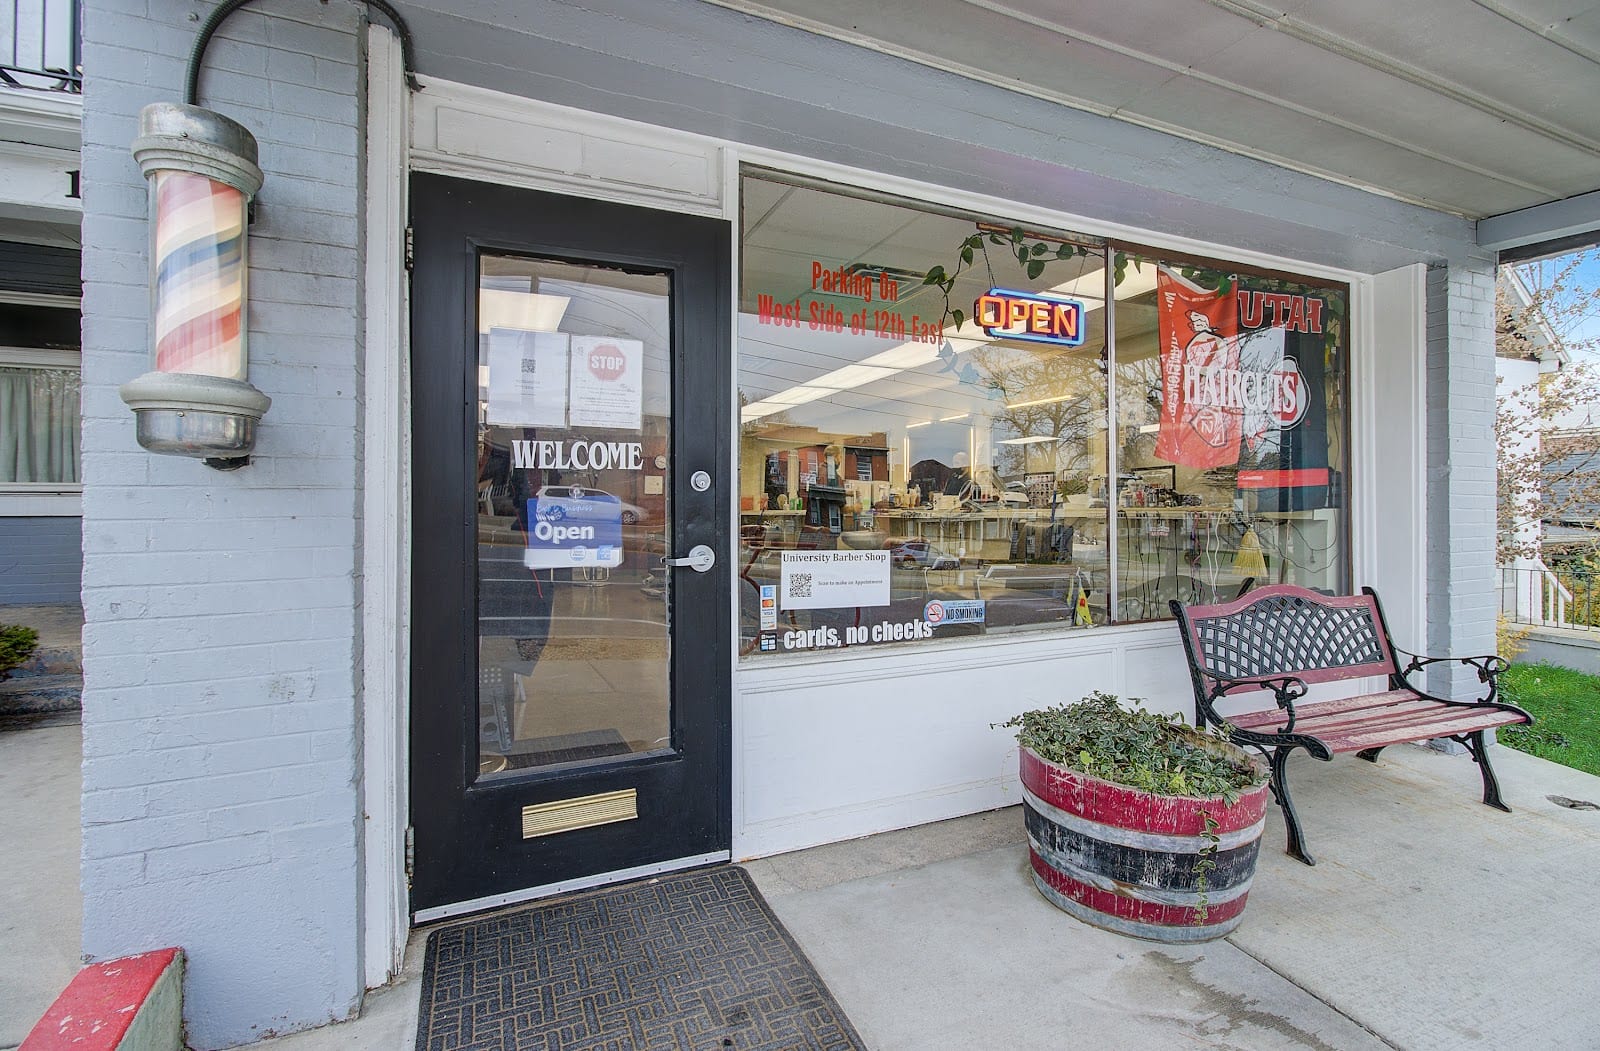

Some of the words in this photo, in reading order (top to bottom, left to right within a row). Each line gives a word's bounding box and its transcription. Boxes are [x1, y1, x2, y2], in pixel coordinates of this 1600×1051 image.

[812, 261, 872, 302] Parking
[879, 272, 898, 302] On
[758, 294, 801, 328] West
[808, 300, 844, 335] Side
[851, 312, 868, 336] of
[875, 310, 905, 342] 12th
[911, 315, 943, 346] East
[978, 295, 1077, 337] OPEN
[1238, 290, 1323, 333] UTAH
[591, 355, 623, 370] STOP
[1183, 363, 1296, 414] HAIRCUTS
[512, 440, 643, 470] WELCOME
[535, 521, 594, 544] Open
[783, 553, 830, 563] University
[833, 552, 863, 561] Barber
[865, 552, 886, 563] Shop
[955, 607, 982, 619] SMOKING
[783, 624, 842, 649] cards,
[846, 624, 869, 644] no
[872, 618, 933, 641] checks
